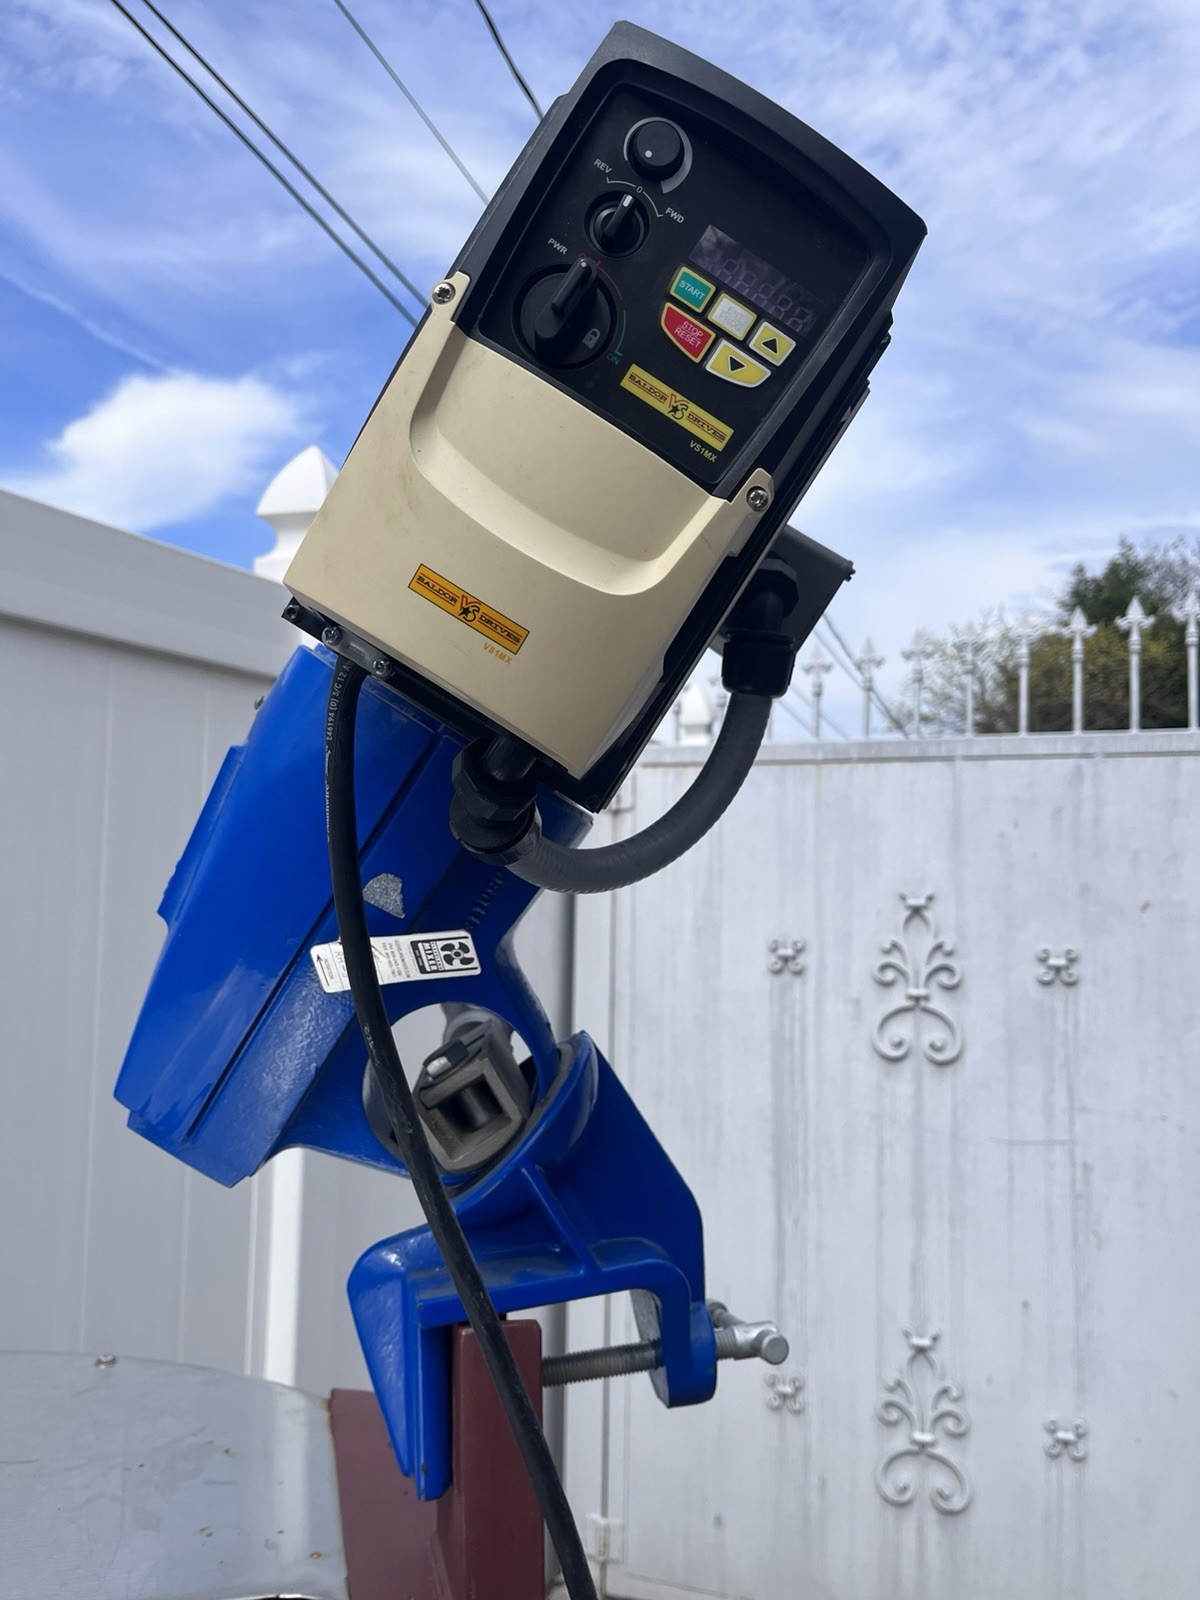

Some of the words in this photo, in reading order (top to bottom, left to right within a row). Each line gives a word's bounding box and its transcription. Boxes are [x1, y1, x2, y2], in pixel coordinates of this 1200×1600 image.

[593, 159, 612, 174] REV
[665, 207, 684, 223] FWD
[547, 238, 568, 254] PWR
[679, 280, 706, 300] START
[674, 327, 702, 348] RESET
[680, 321, 704, 338] STOP
[607, 353, 619, 365] ON
[628, 374, 668, 402] BALDOR
[687, 413, 727, 442] DRIVES
[690, 440, 718, 463] VS1MX
[417, 576, 458, 604] BALDOR
[479, 614, 522, 644] DRIVES
[483, 642, 513, 664] VS1MX
[422, 942, 438, 971] MIXER
